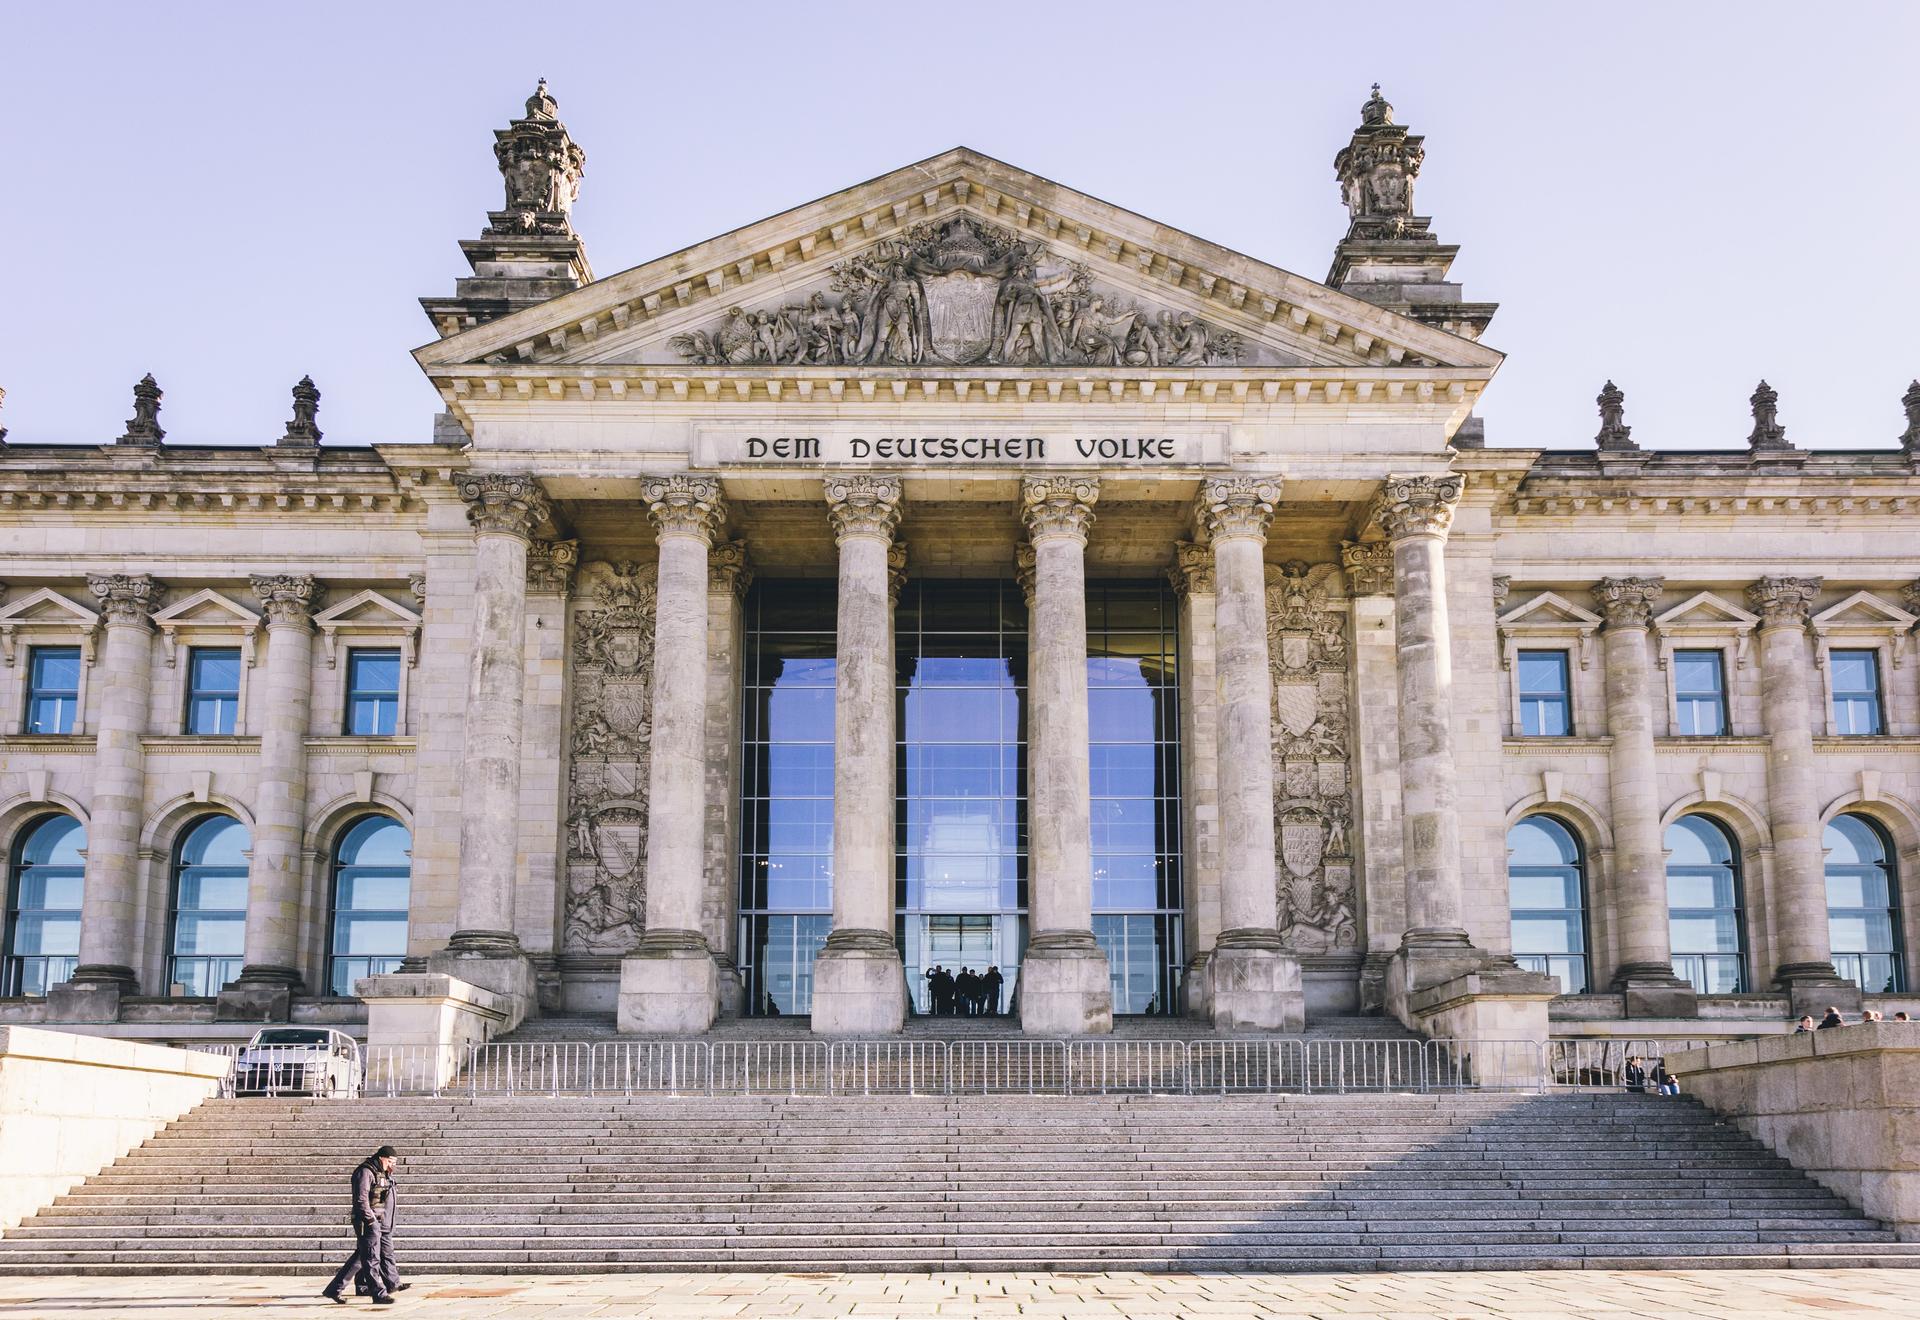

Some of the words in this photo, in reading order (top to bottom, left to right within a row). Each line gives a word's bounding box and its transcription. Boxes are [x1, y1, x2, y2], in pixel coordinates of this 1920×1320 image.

[746, 437, 821, 459] DEM
[849, 437, 1045, 459] DEUTSCHEN
[1075, 438, 1175, 459] VOLKE
